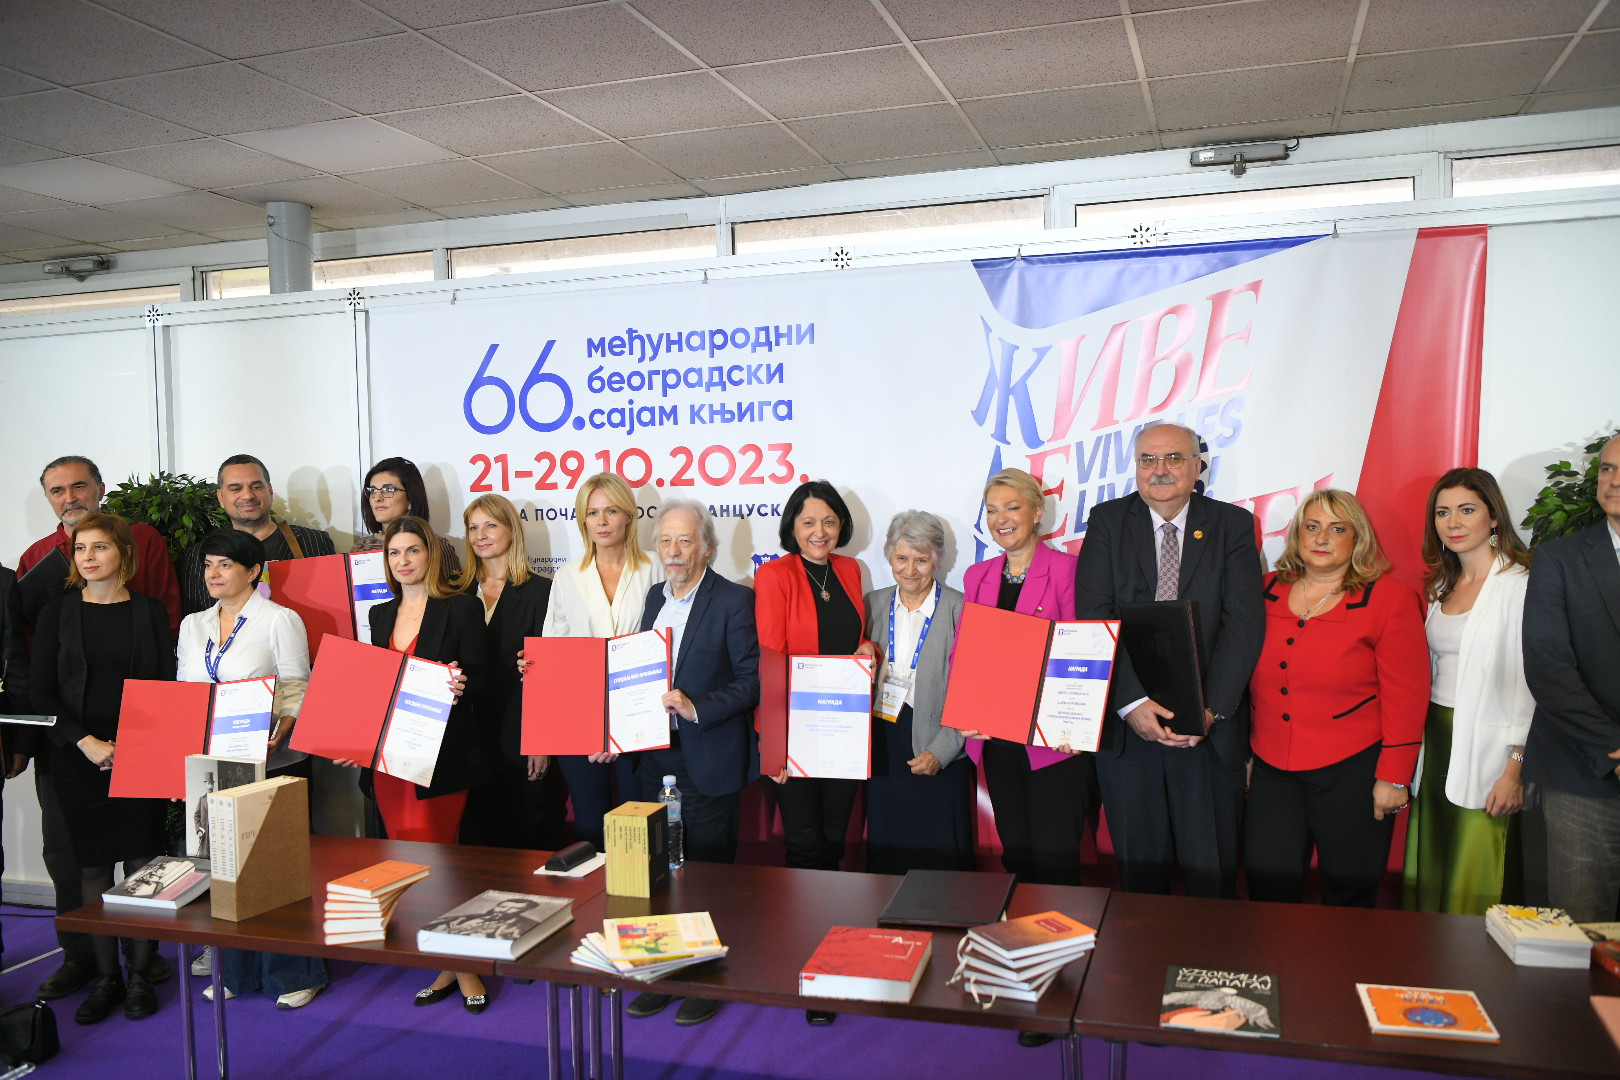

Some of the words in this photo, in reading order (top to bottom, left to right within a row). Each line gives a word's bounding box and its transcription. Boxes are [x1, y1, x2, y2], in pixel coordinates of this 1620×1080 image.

[587, 322, 815, 362] међународни
[587, 362, 784, 397] београдски
[971, 279, 1263, 449] ЖИВЕ
[463, 339, 586, 435] 66.
[588, 399, 679, 436] сајам
[690, 399, 793, 425] књига
[1076, 418, 1164, 485] VIV
[1176, 397, 1246, 449] ES
[469, 442, 810, 493] 21-2910.2023.
[535, 507, 577, 521] ПОЧА
[708, 503, 782, 519] АНЦУСК
[817, 698, 843, 706] НАГРАДА
